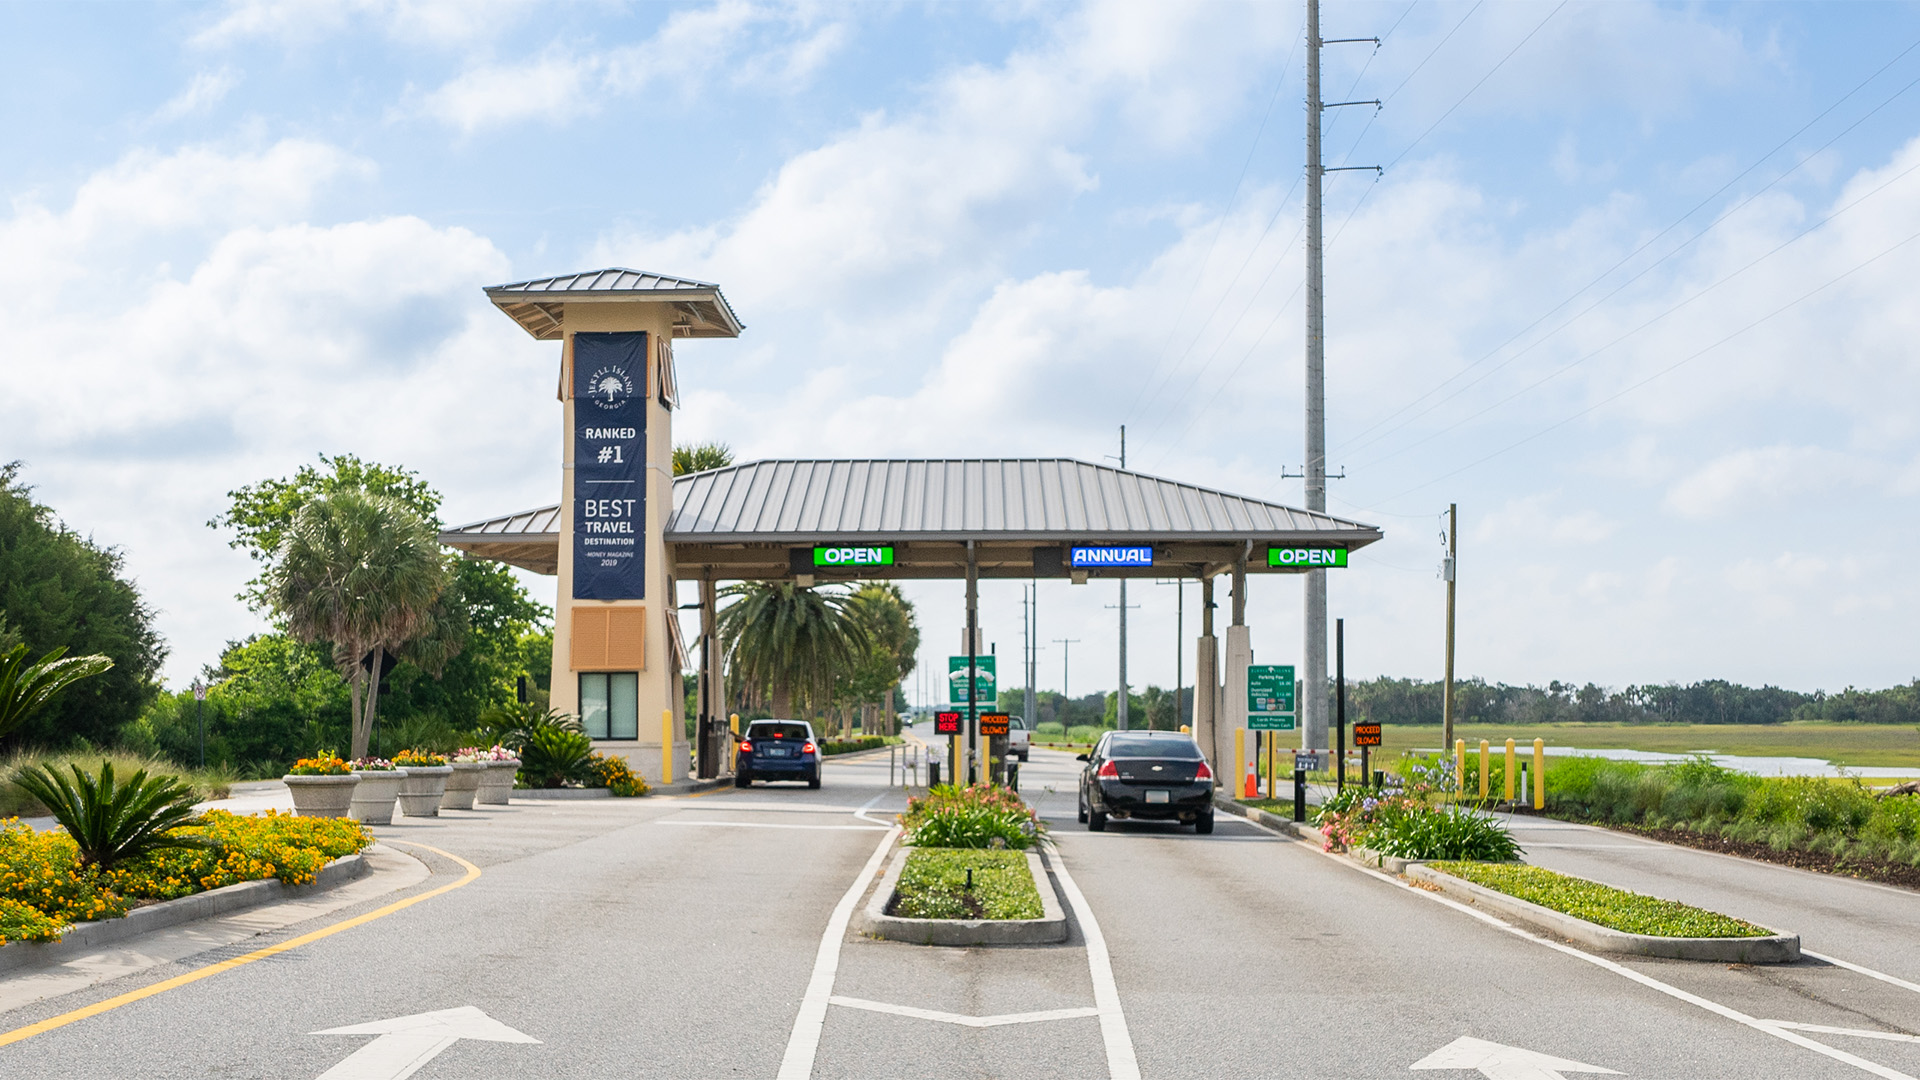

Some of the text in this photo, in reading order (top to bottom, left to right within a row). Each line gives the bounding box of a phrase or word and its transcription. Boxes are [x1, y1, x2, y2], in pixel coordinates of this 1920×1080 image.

[588, 365, 633, 394] JEKYLL ISLAND
[594, 399, 626, 409] GEORGIA
[585, 428, 636, 439] RANKED
[597, 445, 624, 463] #1
[585, 499, 636, 517] BEST
[584, 521, 634, 533] TRAVEL
[584, 537, 634, 545] DESTINATION
[824, 547, 882, 563] OPEN
[1073, 549, 1152, 562] ANNUAL
[1279, 549, 1336, 564] OPEN
[939, 713, 958, 722] STOP
[938, 722, 958, 731] HERE
[981, 726, 1007, 734] SLOWLY
[1356, 726, 1380, 734] PROCEED
[1356, 736, 1380, 745] SLOWLY
